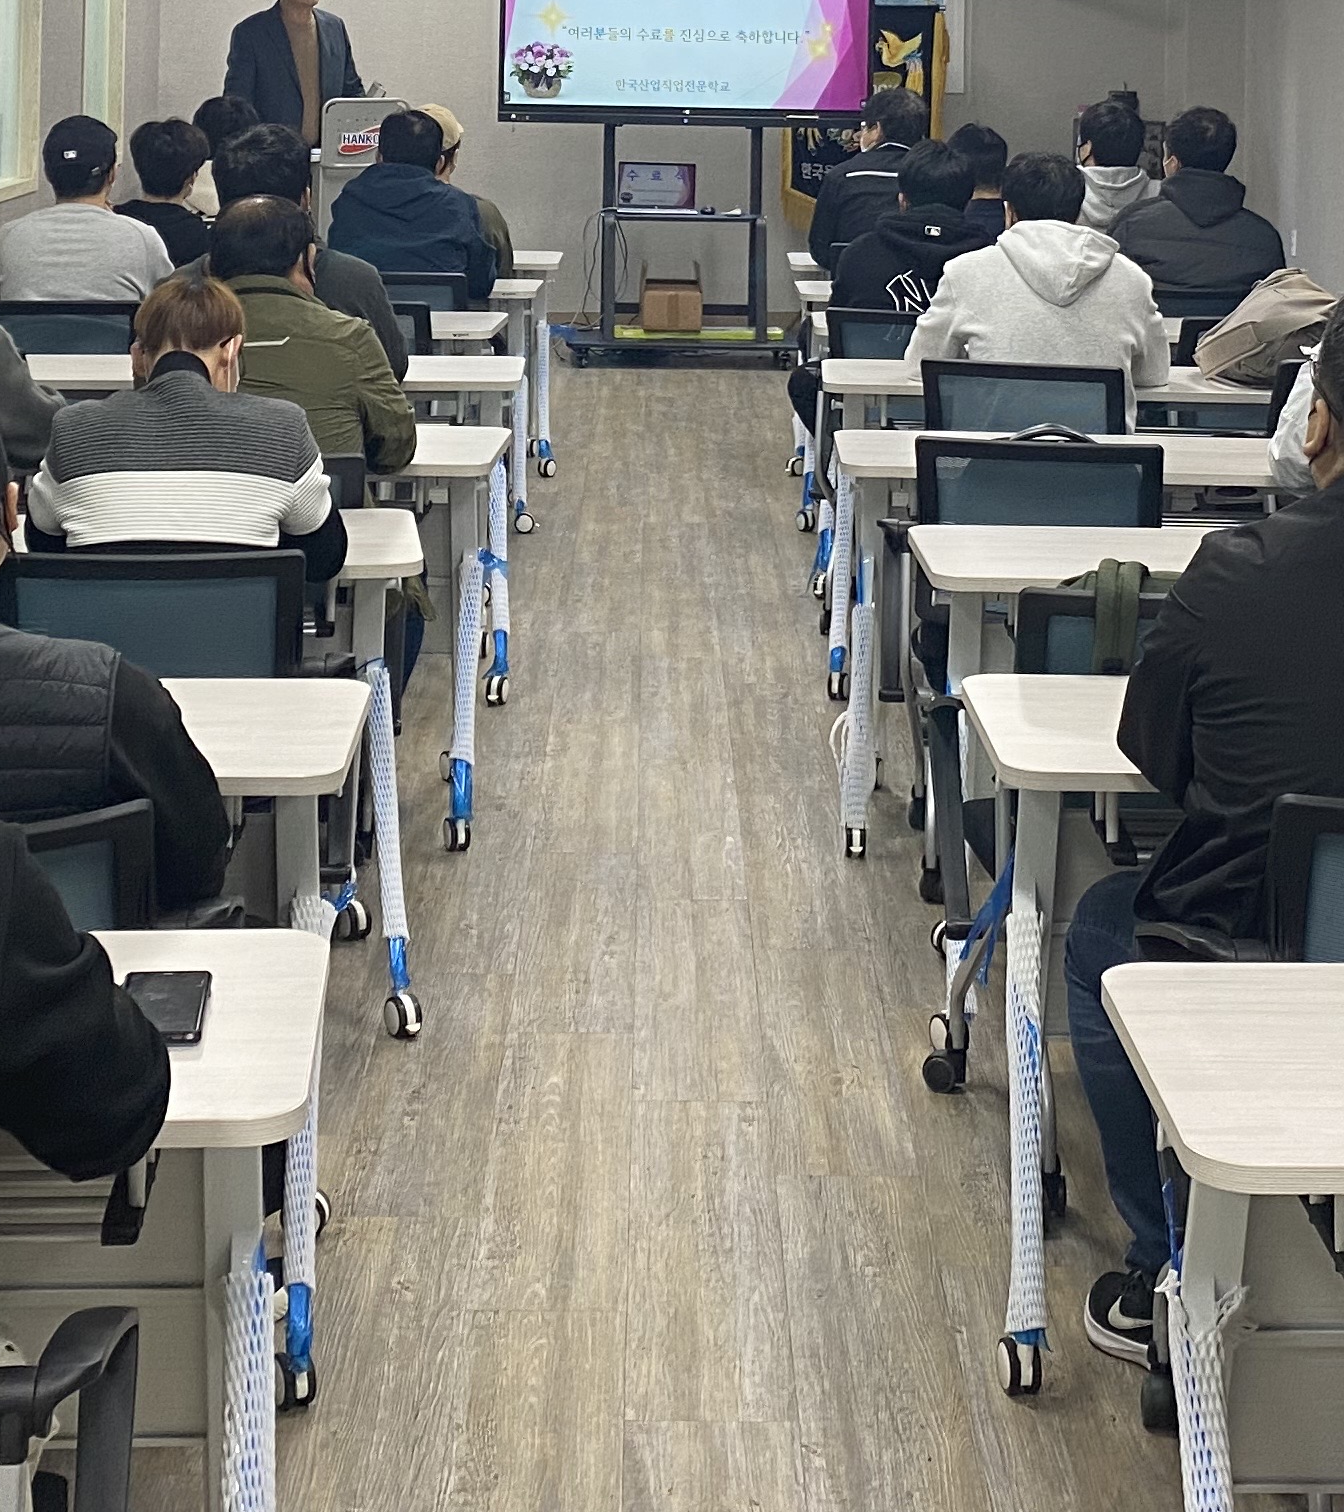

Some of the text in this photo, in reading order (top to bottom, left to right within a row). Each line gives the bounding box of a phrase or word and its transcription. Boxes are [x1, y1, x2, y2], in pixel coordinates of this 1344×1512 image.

[636, 28, 675, 43] 수료를
[679, 29, 732, 43] 진심으로
[615, 78, 732, 93] 한국산업직업전문학교
